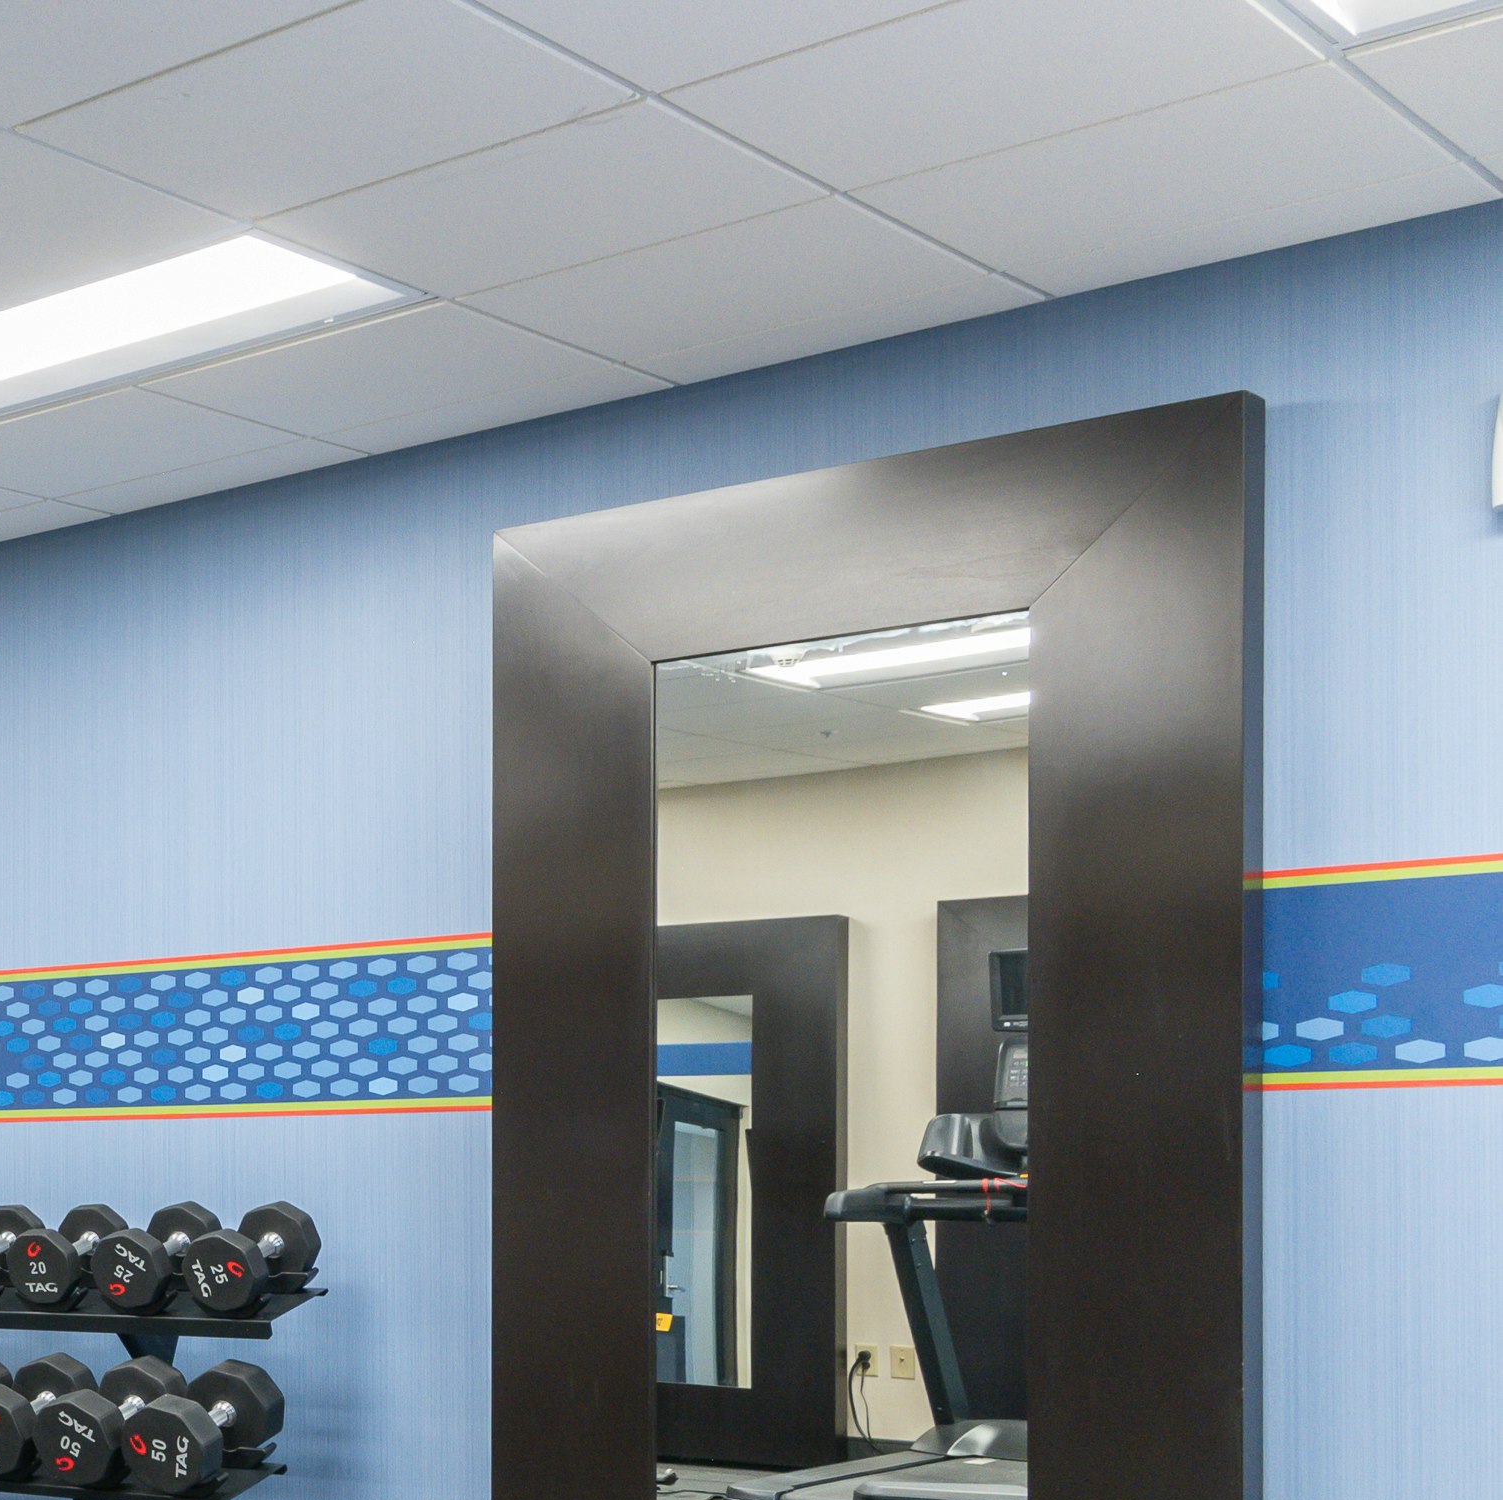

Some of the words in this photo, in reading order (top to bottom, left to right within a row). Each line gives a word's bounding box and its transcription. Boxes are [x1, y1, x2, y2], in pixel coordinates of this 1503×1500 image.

[29, 1262, 46, 1275] 20
[114, 1244, 147, 1272] TAG
[114, 1265, 133, 1283] 25
[191, 1259, 212, 1298] TAG
[210, 1264, 228, 1284] 25
[25, 1283, 58, 1293] TAG
[58, 1411, 96, 1442] TAG
[60, 1436, 81, 1458] 50
[152, 1439, 167, 1462] 50
[175, 1436, 190, 1478] TAG
